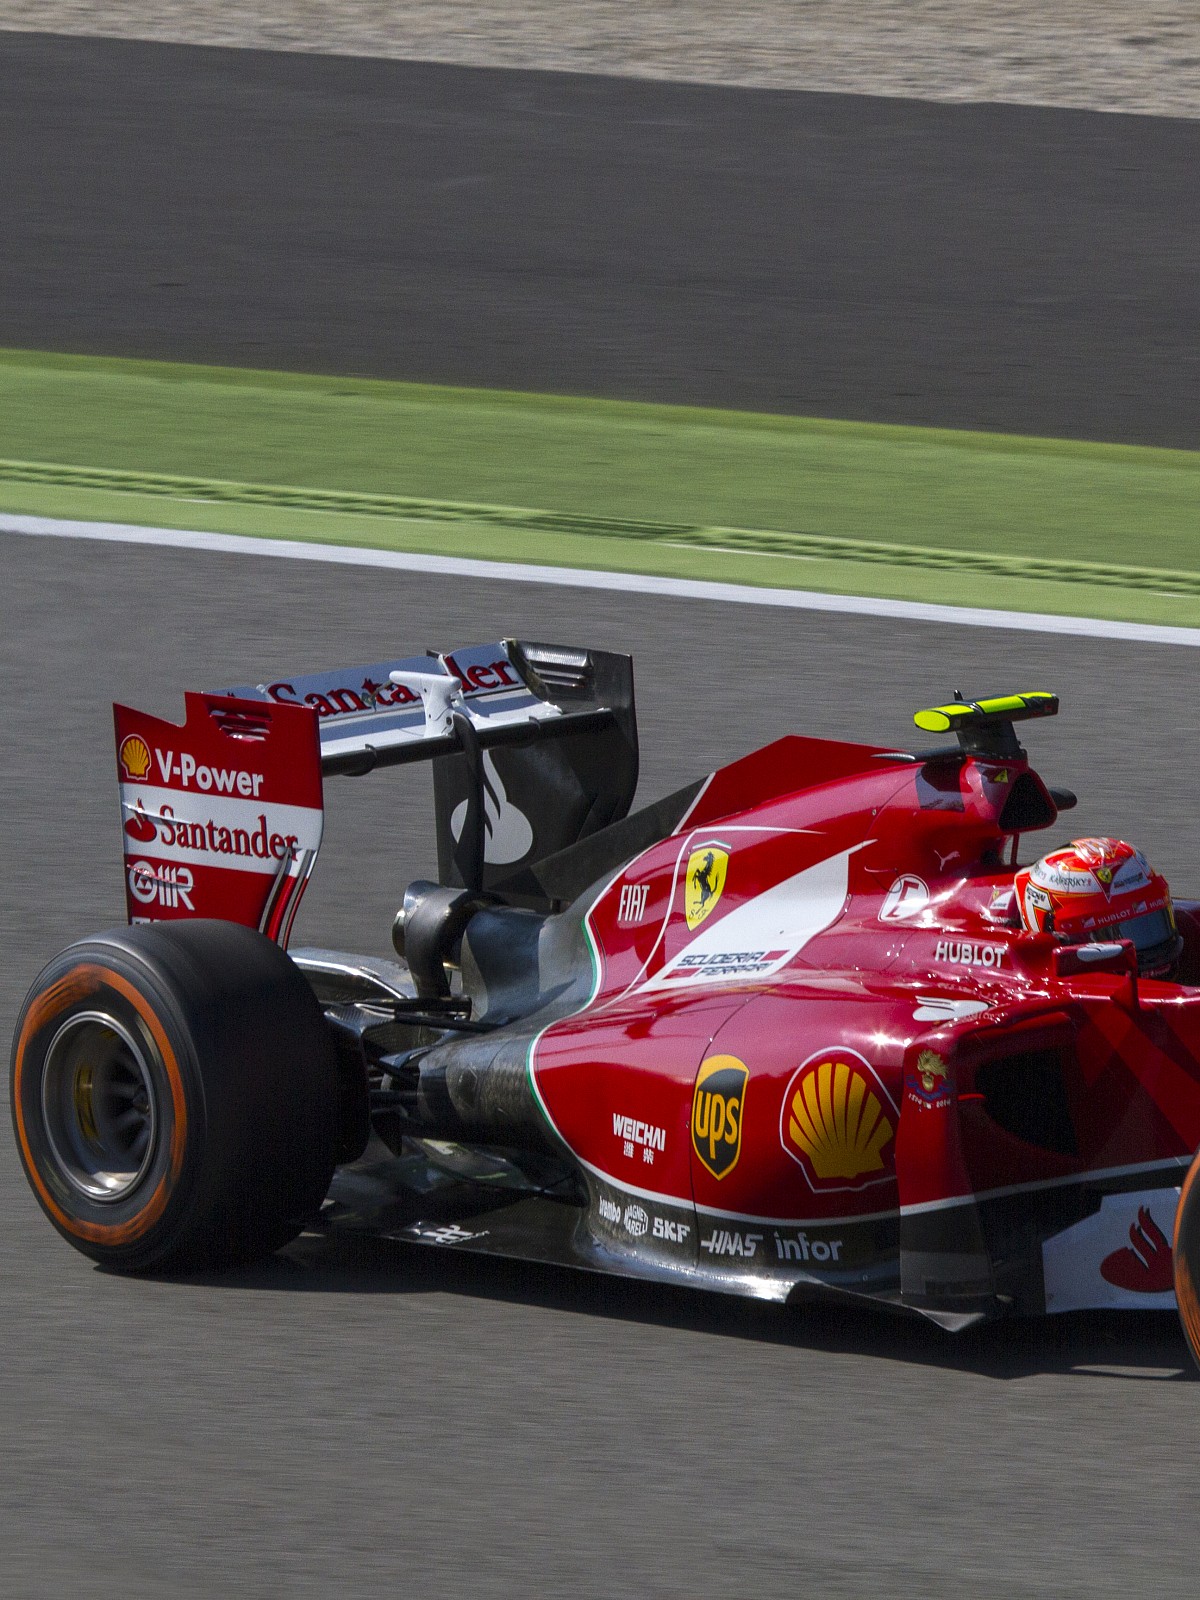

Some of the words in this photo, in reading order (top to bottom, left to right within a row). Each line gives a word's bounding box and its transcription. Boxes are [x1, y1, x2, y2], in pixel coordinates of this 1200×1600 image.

[267, 655, 519, 717] Santader
[155, 748, 264, 797] V-Power
[160, 804, 299, 862] Santander
[618, 884, 650, 922] FIAT
[1097, 909, 1131, 925] HUBLOT
[677, 951, 765, 967] SCUDERIA
[694, 962, 774, 977] FERRARI
[935, 941, 1006, 968] HUBLOT
[612, 1112, 667, 1152] WEICHAI
[696, 1089, 740, 1160] ups
[652, 1216, 691, 1244] SKF
[701, 1229, 764, 1257] HAAS
[775, 1231, 842, 1262] infor
